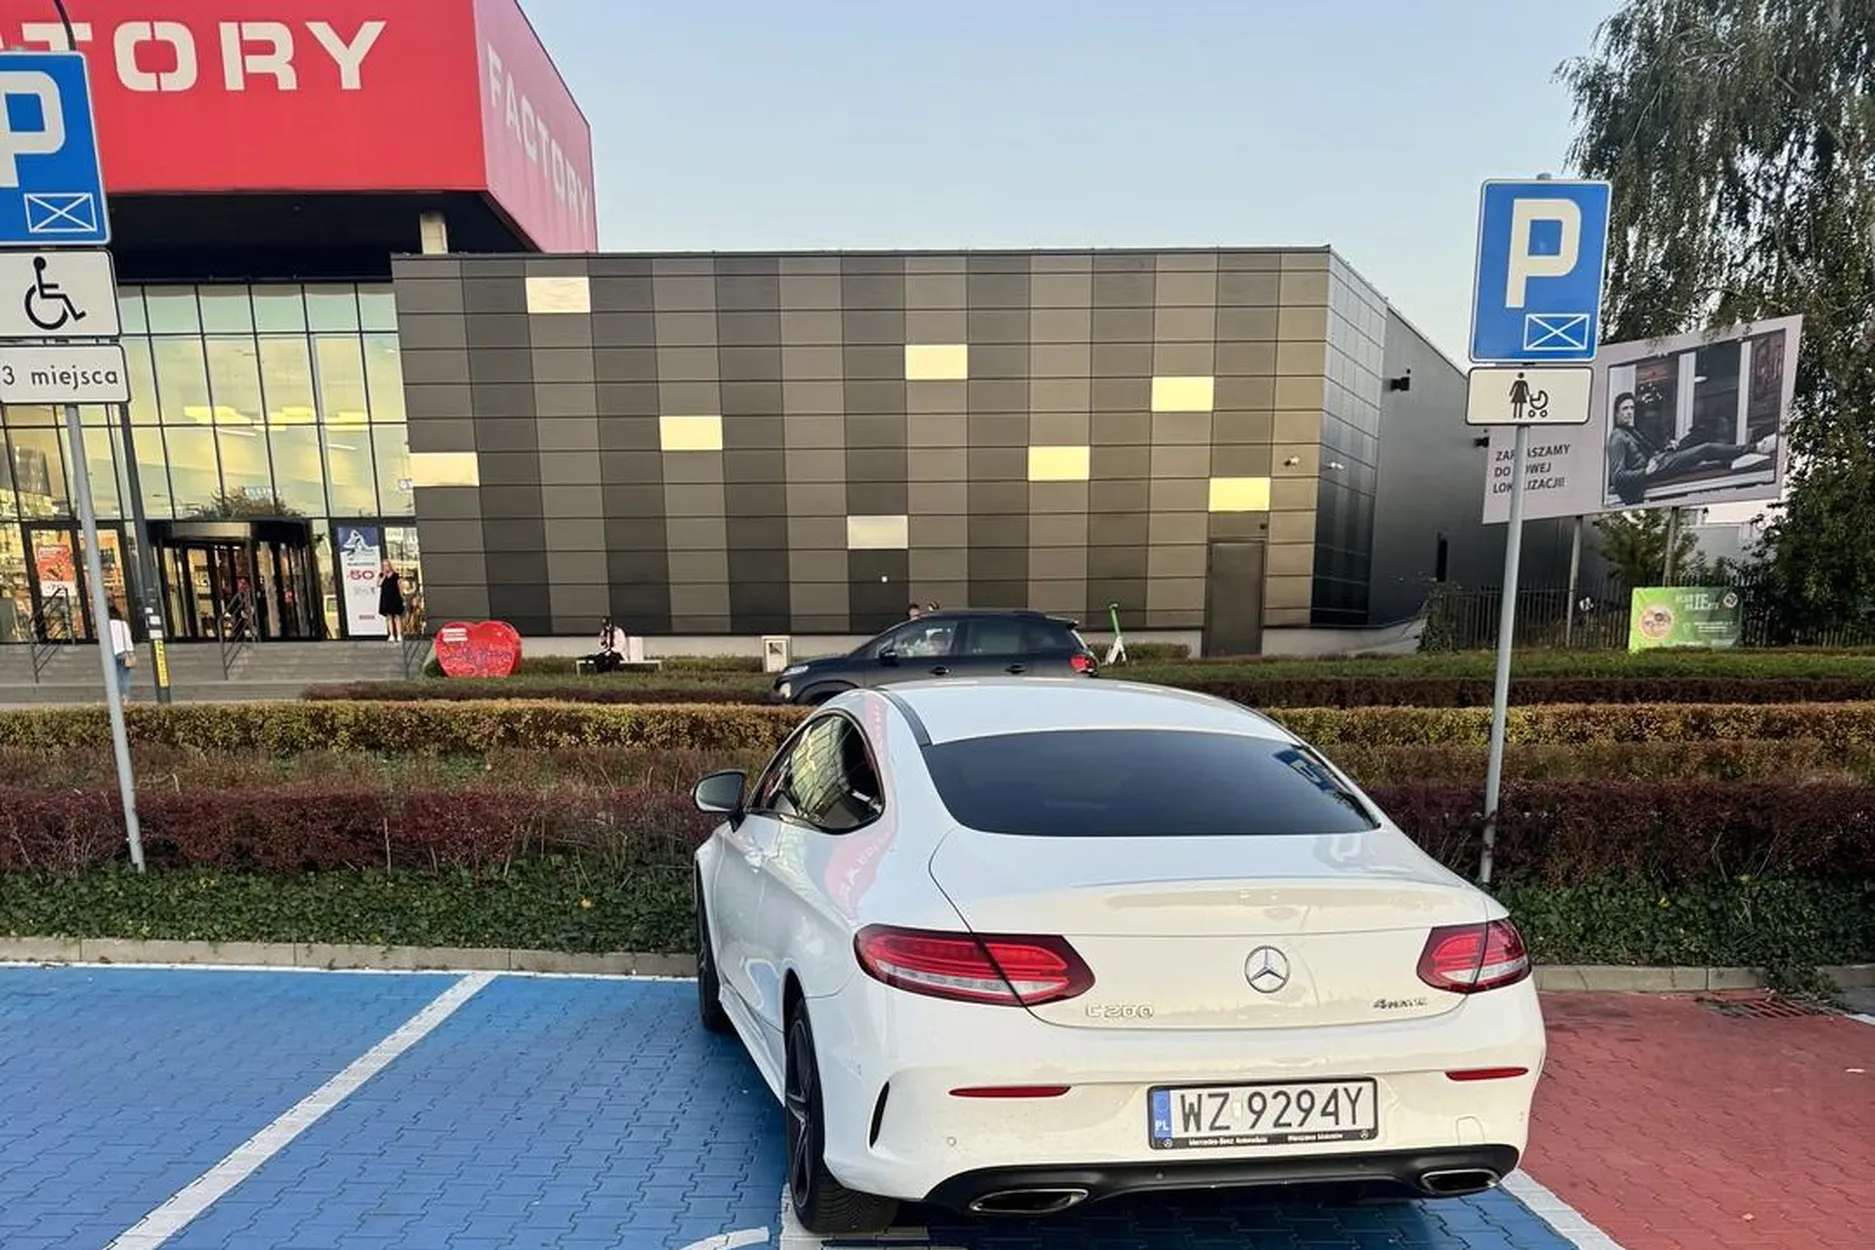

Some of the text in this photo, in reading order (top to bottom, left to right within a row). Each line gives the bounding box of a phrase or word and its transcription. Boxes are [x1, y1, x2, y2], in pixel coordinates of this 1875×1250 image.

[0, 21, 387, 91] TORY
[0, 70, 65, 188] P
[487, 42, 589, 234] FACTORY
[1505, 198, 1582, 308] P
[2, 365, 118, 390] 3 miejsca
[1494, 466, 1511, 477] DO
[1085, 1004, 1155, 1018] C 200
[1155, 1119, 1169, 1131] PL
[1180, 1086, 1363, 1132] WZ 9294Y
